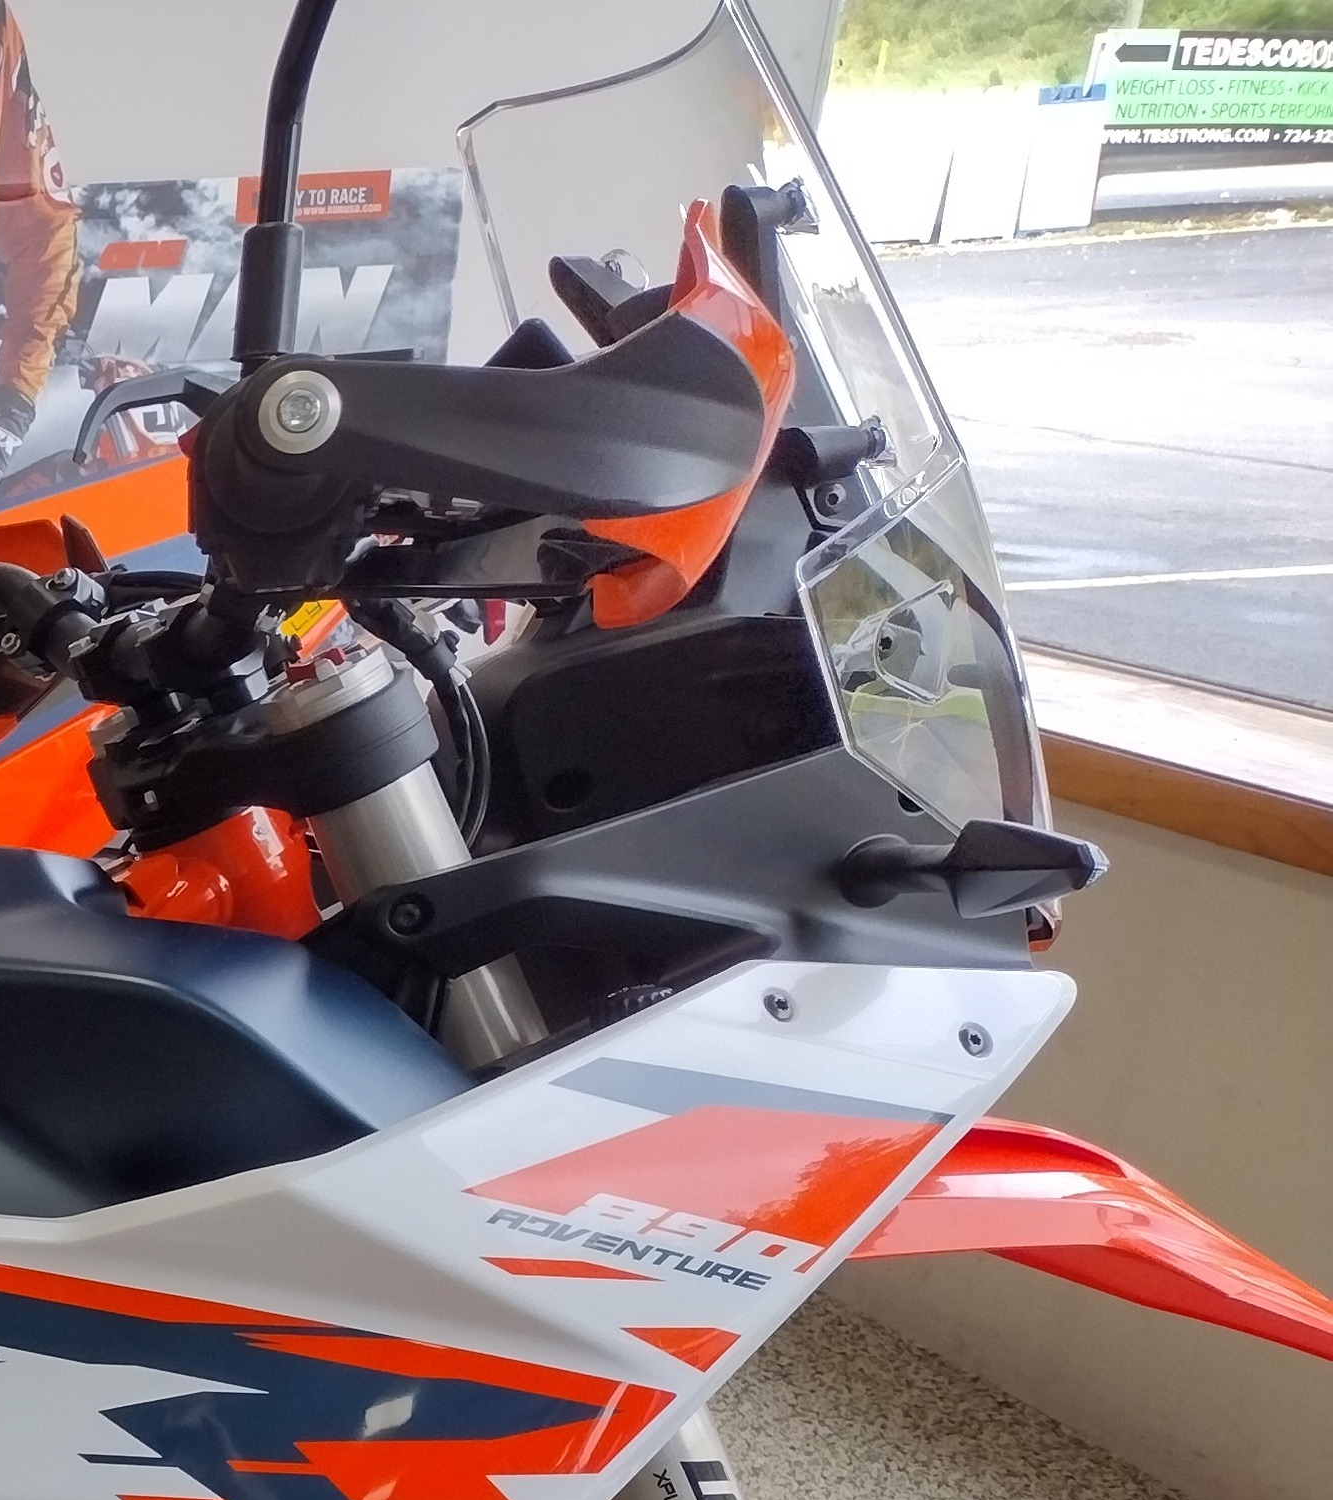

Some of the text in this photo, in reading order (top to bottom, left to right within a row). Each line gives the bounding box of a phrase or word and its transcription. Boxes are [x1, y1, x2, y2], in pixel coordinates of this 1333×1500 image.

[1116, 79, 1175, 95] WEIGHT
[1178, 79, 1215, 95] LOSS
[1228, 79, 1285, 95] FITNESS
[1115, 103, 1198, 119] NUTRITION
[1210, 103, 1266, 118] SPORTS
[309, 189, 326, 205] TO
[330, 187, 367, 205] RACE
[486, 1208, 773, 1292] ADVENTURE
